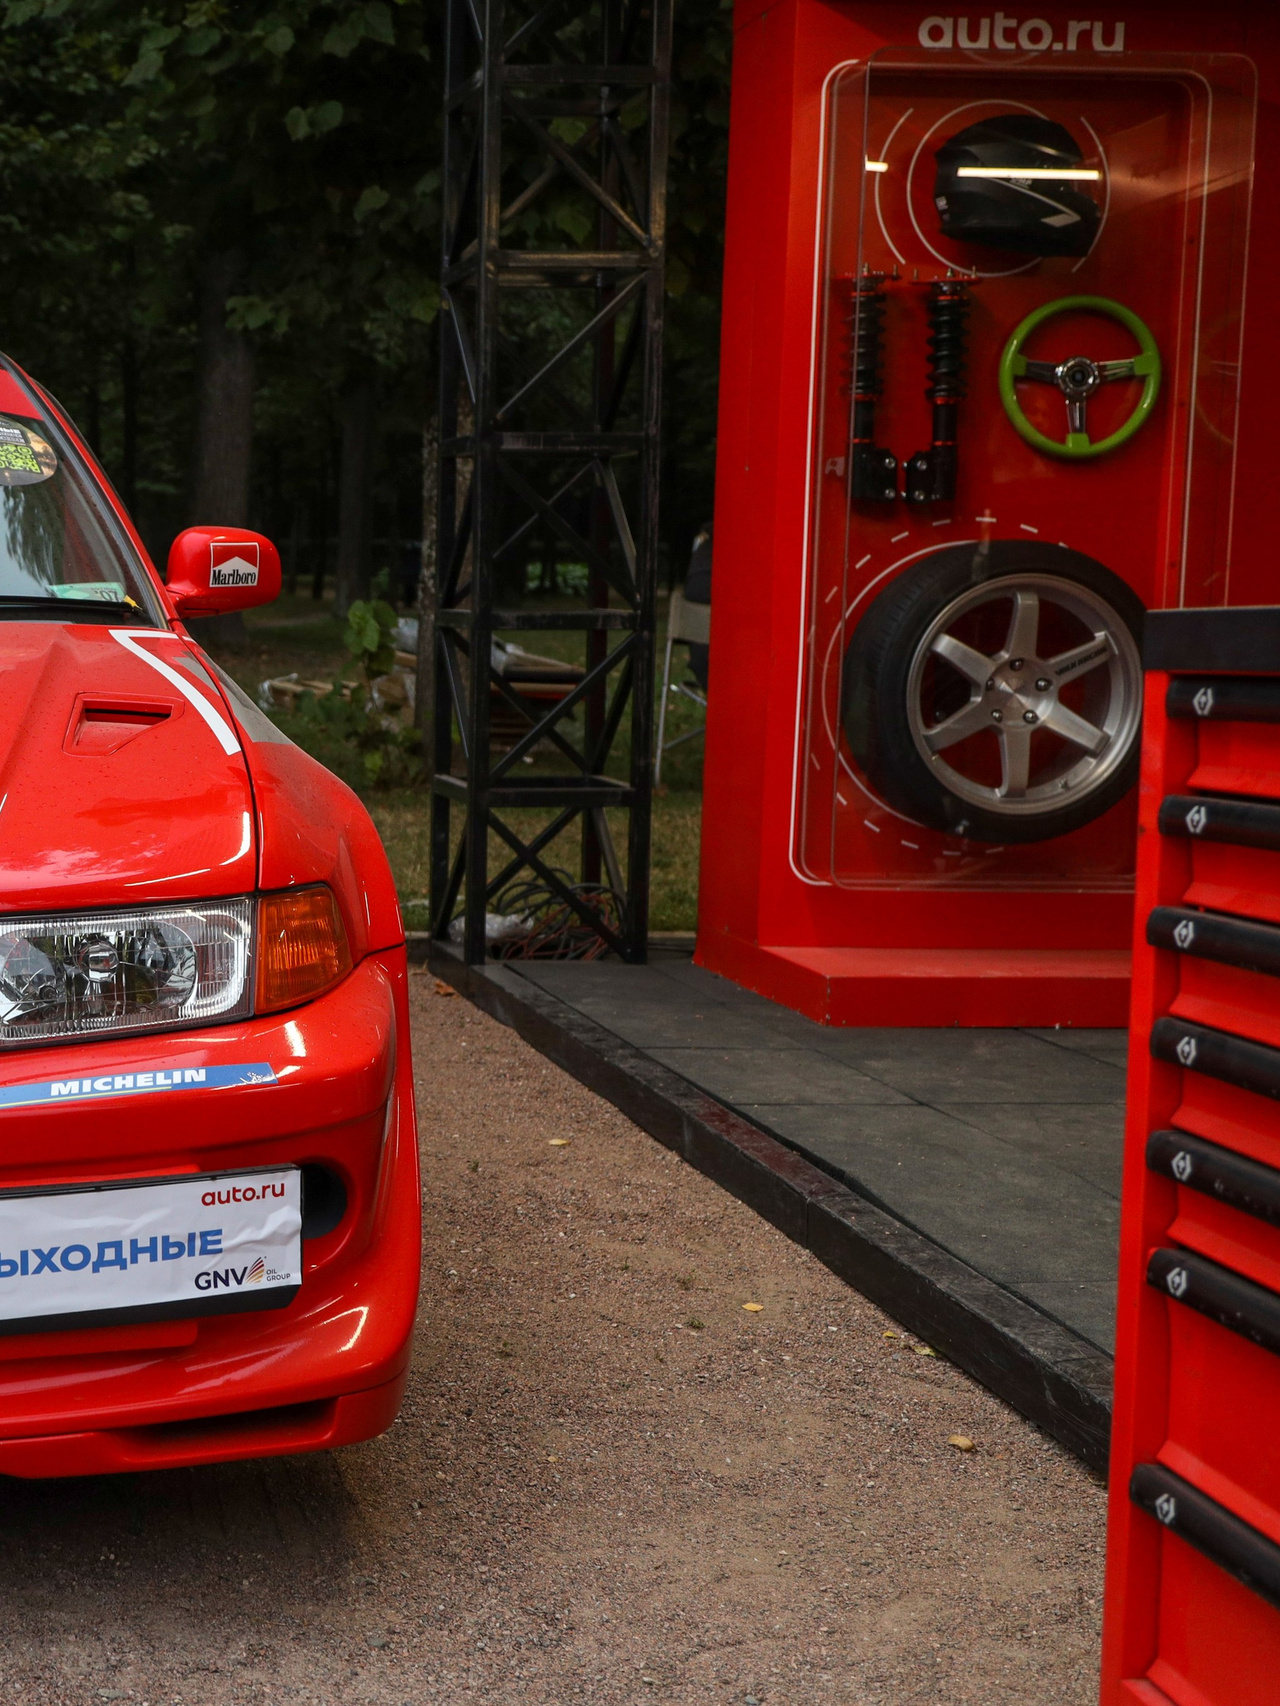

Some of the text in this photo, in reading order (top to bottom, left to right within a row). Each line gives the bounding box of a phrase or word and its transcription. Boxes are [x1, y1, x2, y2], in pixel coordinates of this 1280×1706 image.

[918, 12, 1125, 51] auto.ru
[211, 569, 256, 585] Marlboro
[50, 1069, 206, 1096] MICHELIN
[201, 1183, 285, 1206] auto.ru
[194, 1266, 248, 1291] GNV
[266, 1273, 291, 1282] GROUP
